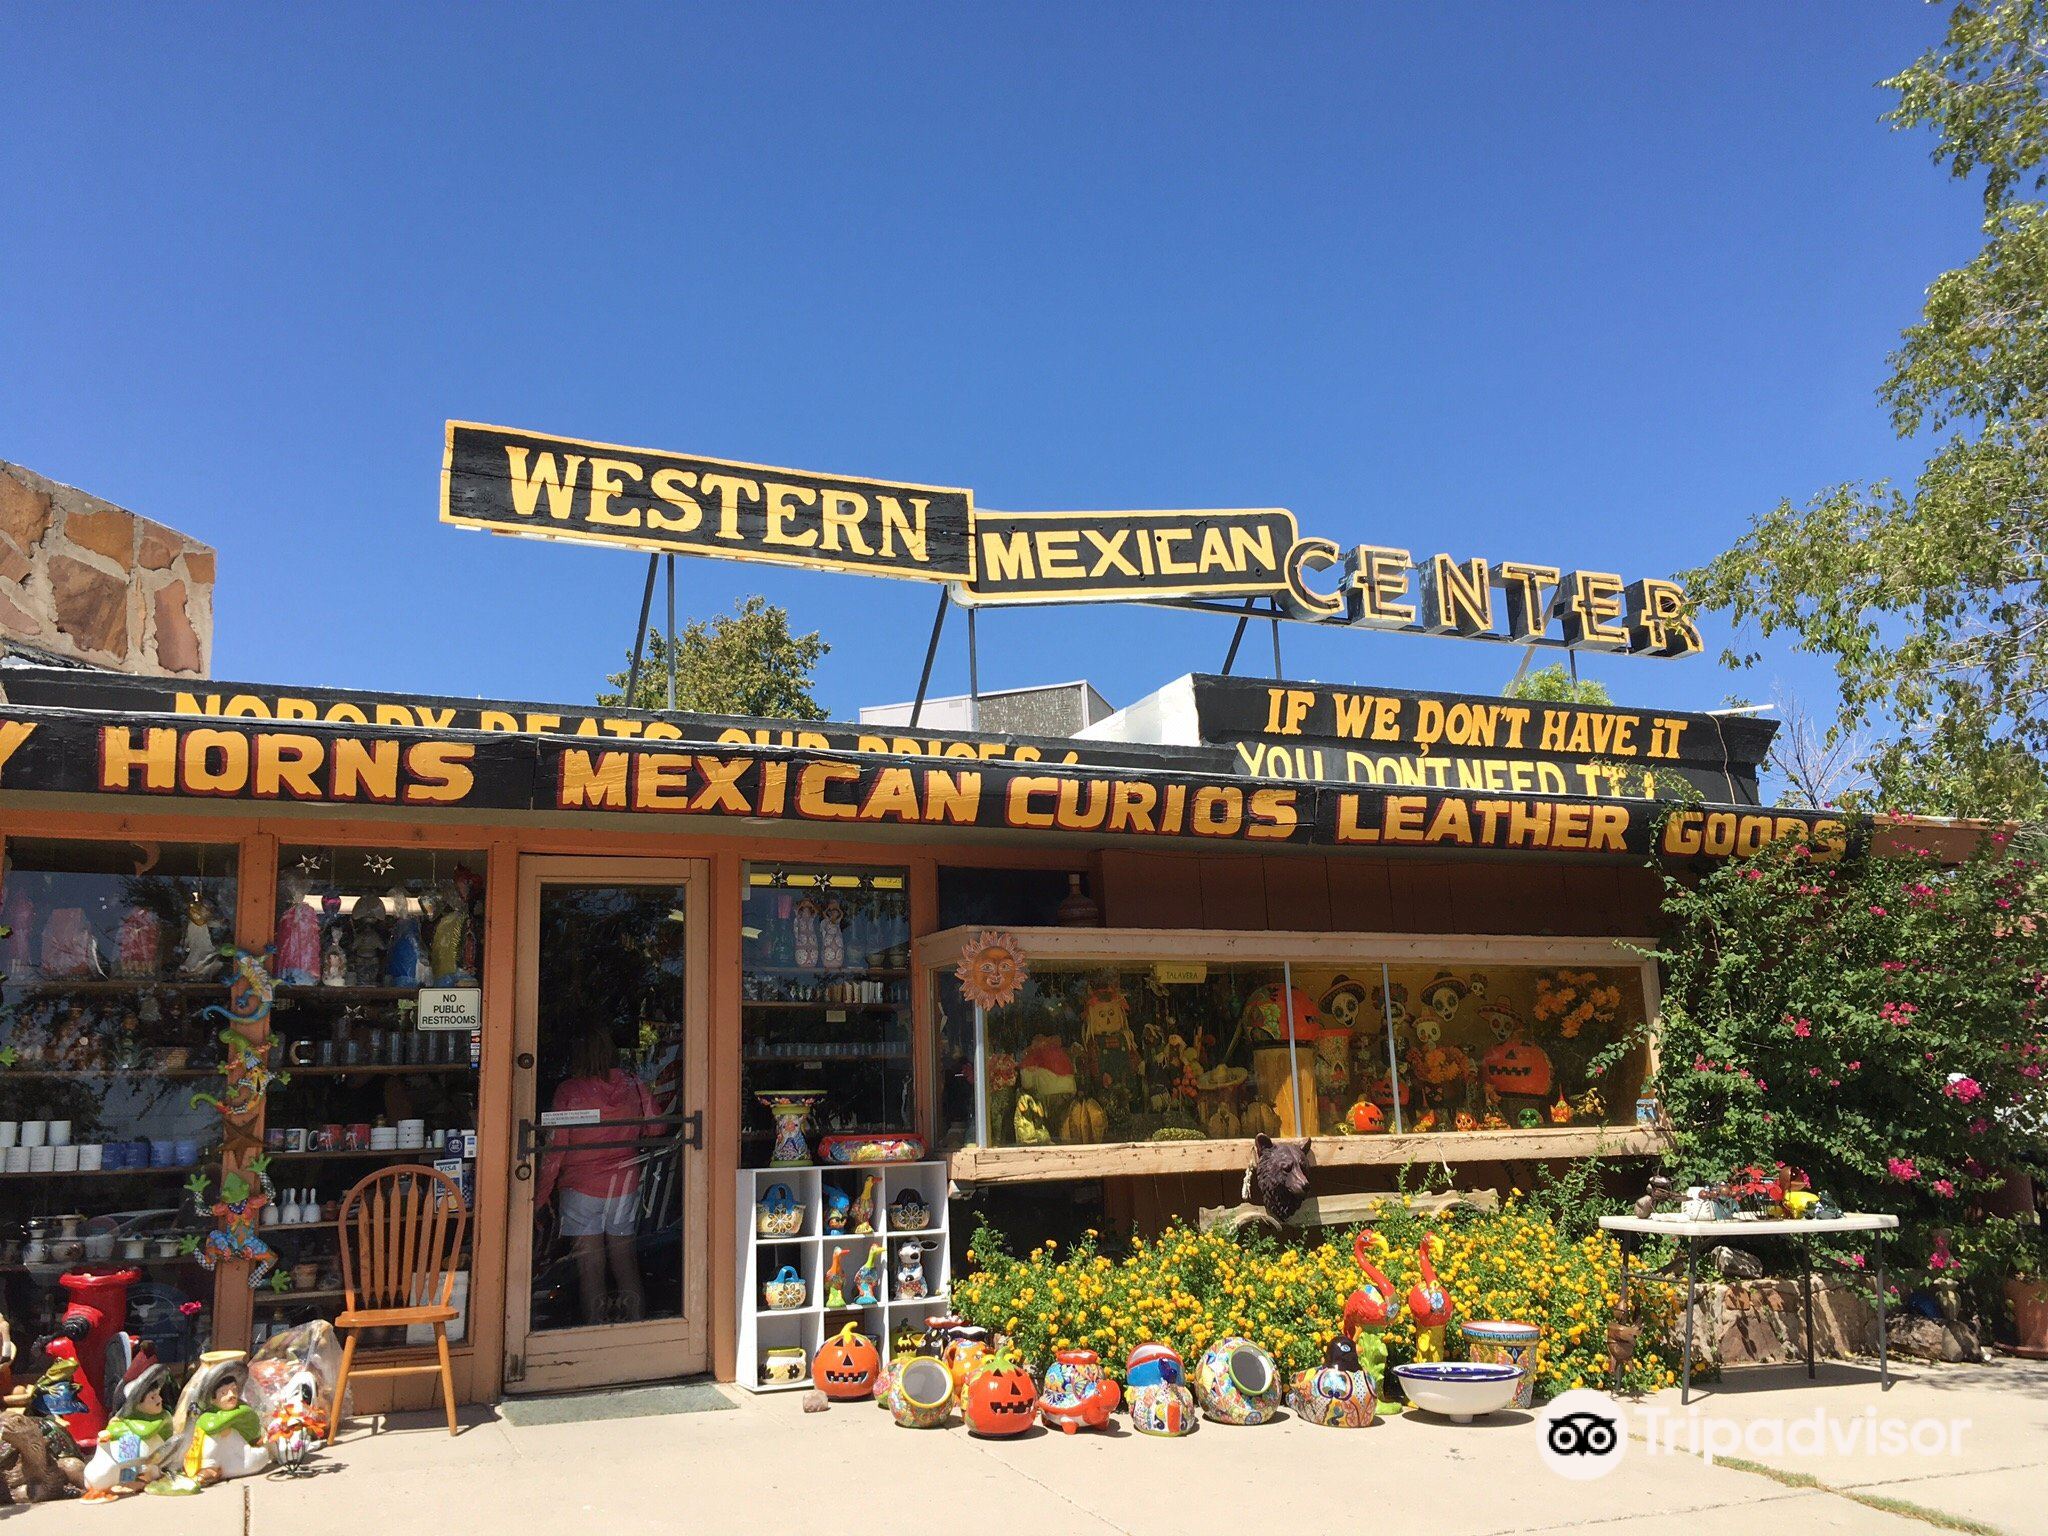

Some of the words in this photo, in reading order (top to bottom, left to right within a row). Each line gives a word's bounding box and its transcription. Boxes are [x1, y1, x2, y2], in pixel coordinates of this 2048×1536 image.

[504, 445, 931, 562] WESTERN
[981, 524, 1277, 582] MEXICAN
[1283, 536, 1706, 657] CENTER
[1263, 688, 1316, 735] IF
[1332, 692, 1401, 741] WE
[1413, 699, 1531, 748] DON'T
[1540, 709, 1641, 757] HAVE
[98, 725, 476, 804] HORNS
[558, 748, 982, 825] MEXICAN
[1005, 775, 1299, 842] CURIOS
[1335, 793, 1630, 852] LEATHER
[421, 1015, 477, 1025] RESTROOMS
[433, 1004, 466, 1014] PUBLIC
[442, 993, 457, 1003] NO
[439, 1164, 457, 1172] VISA
